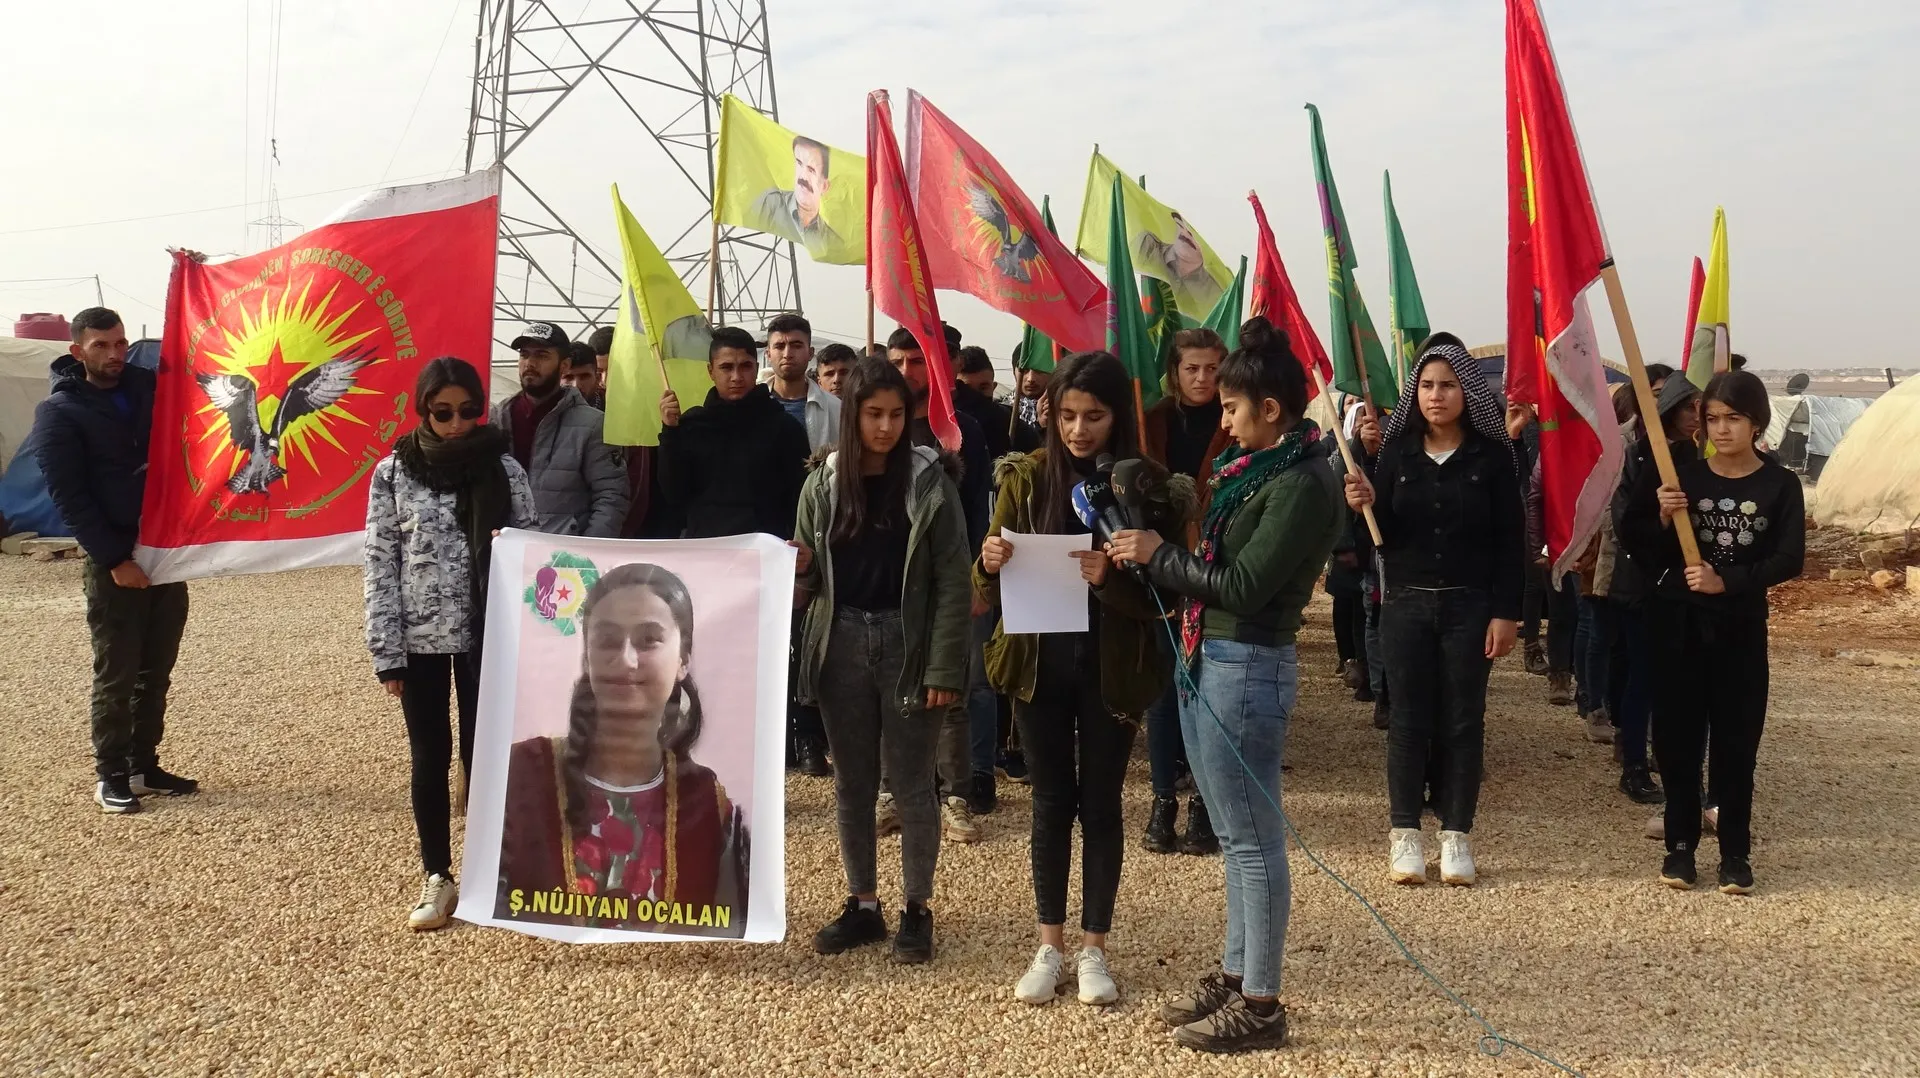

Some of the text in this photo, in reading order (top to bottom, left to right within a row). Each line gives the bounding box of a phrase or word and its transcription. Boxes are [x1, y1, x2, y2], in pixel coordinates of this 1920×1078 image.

[290, 247, 373, 285] ŞOREŞGER
[509, 886, 732, 929] Ş.NÛJIYAN OCALAN
